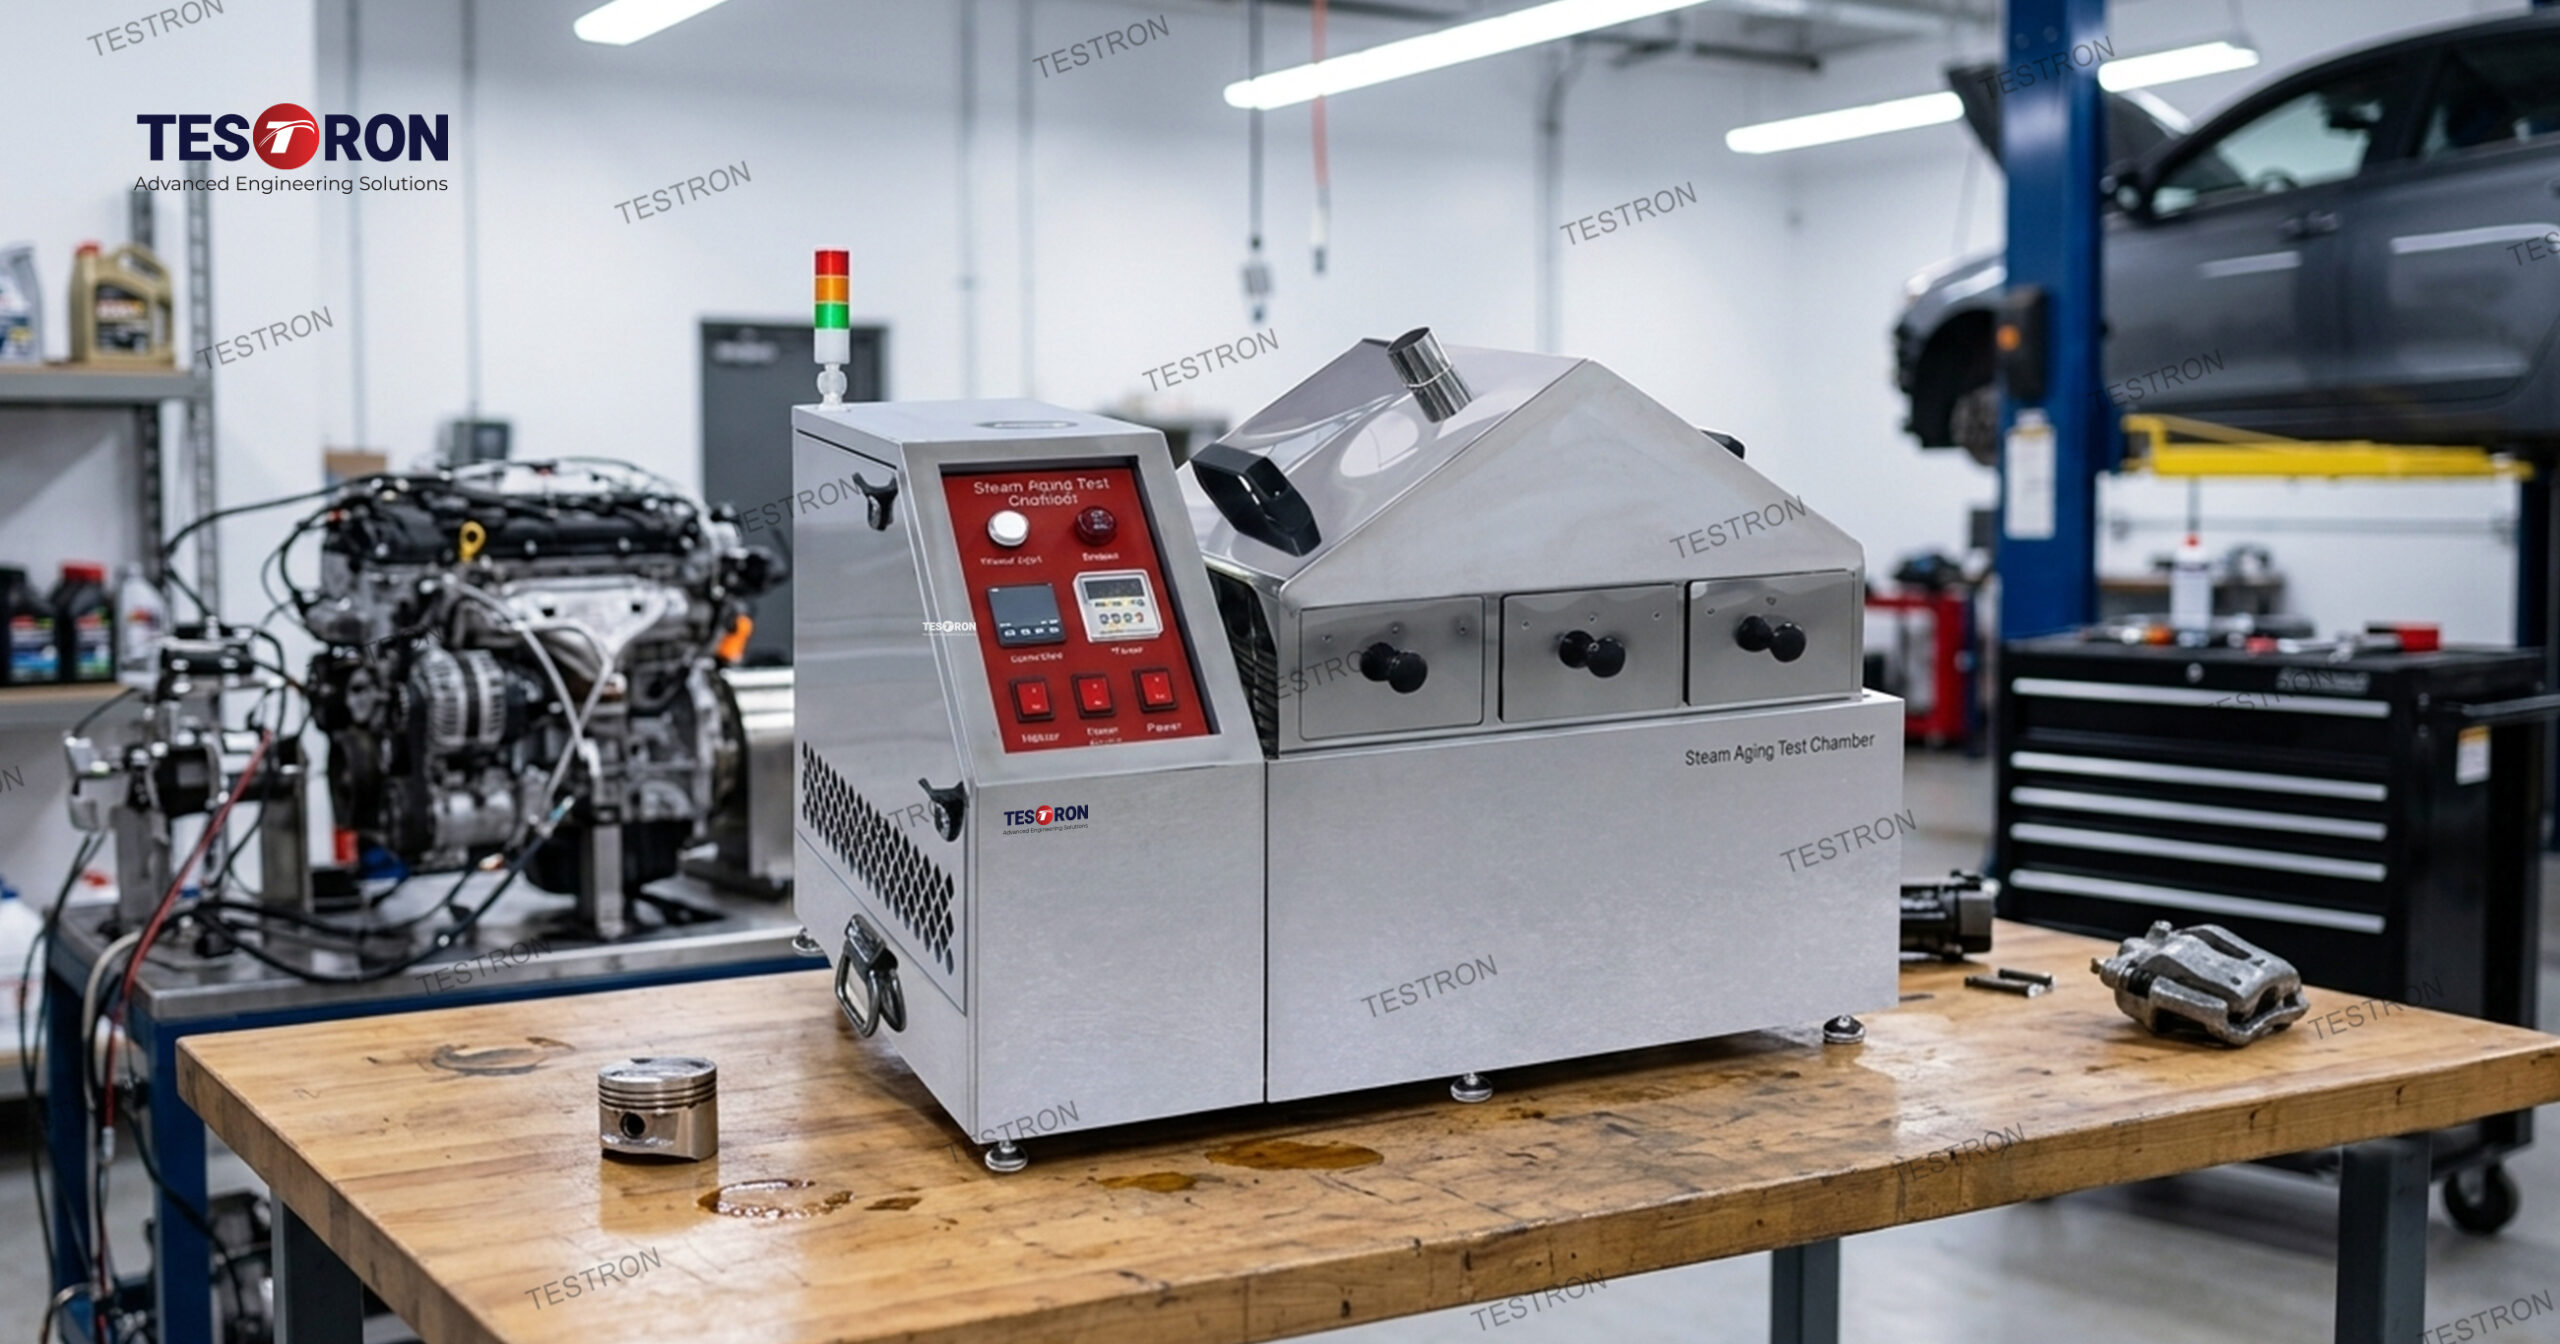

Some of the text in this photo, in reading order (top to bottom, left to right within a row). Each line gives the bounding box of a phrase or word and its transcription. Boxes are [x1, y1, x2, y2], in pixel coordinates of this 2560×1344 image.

[1685, 733, 1875, 766] Steam Aging Test Chamber
[1004, 804, 1088, 826] TESTRON
